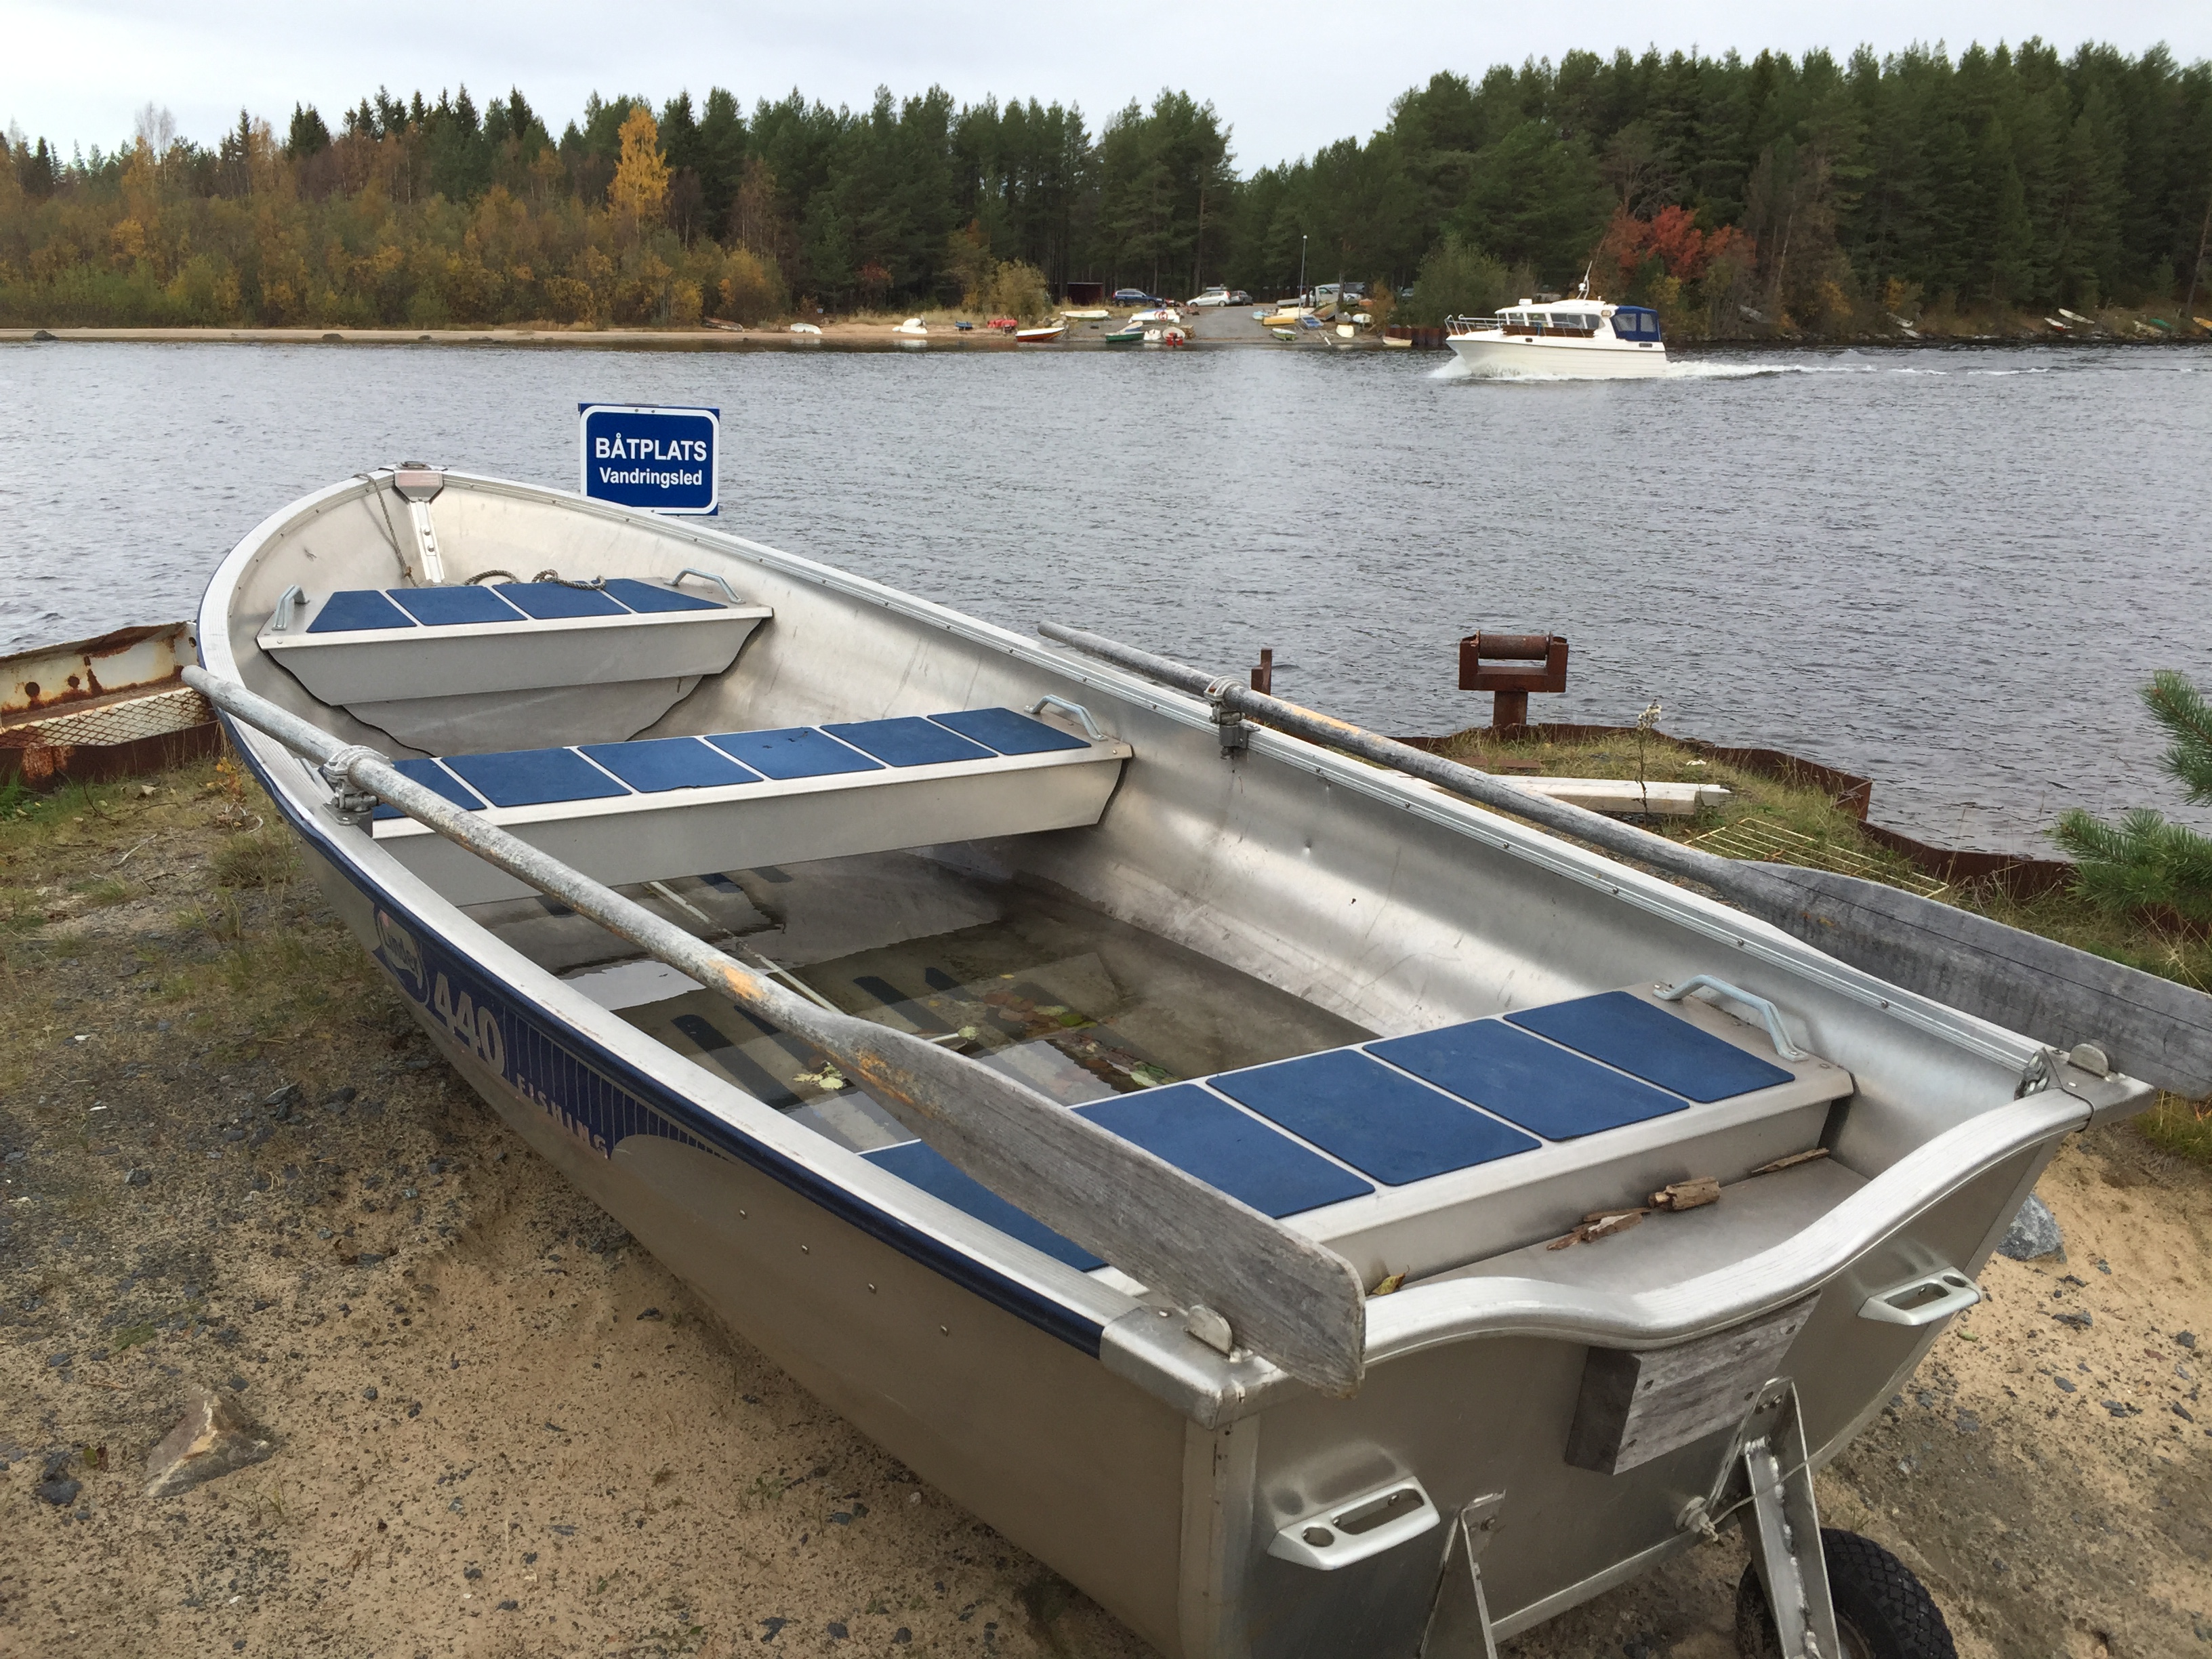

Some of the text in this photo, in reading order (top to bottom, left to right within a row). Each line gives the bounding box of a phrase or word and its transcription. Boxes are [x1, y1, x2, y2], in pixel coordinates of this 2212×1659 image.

[595, 432, 708, 462] BÅTPLATS
[599, 466, 703, 489] Vandringsled
[434, 971, 505, 1076] 440
[516, 1072, 609, 1160] FISHING
